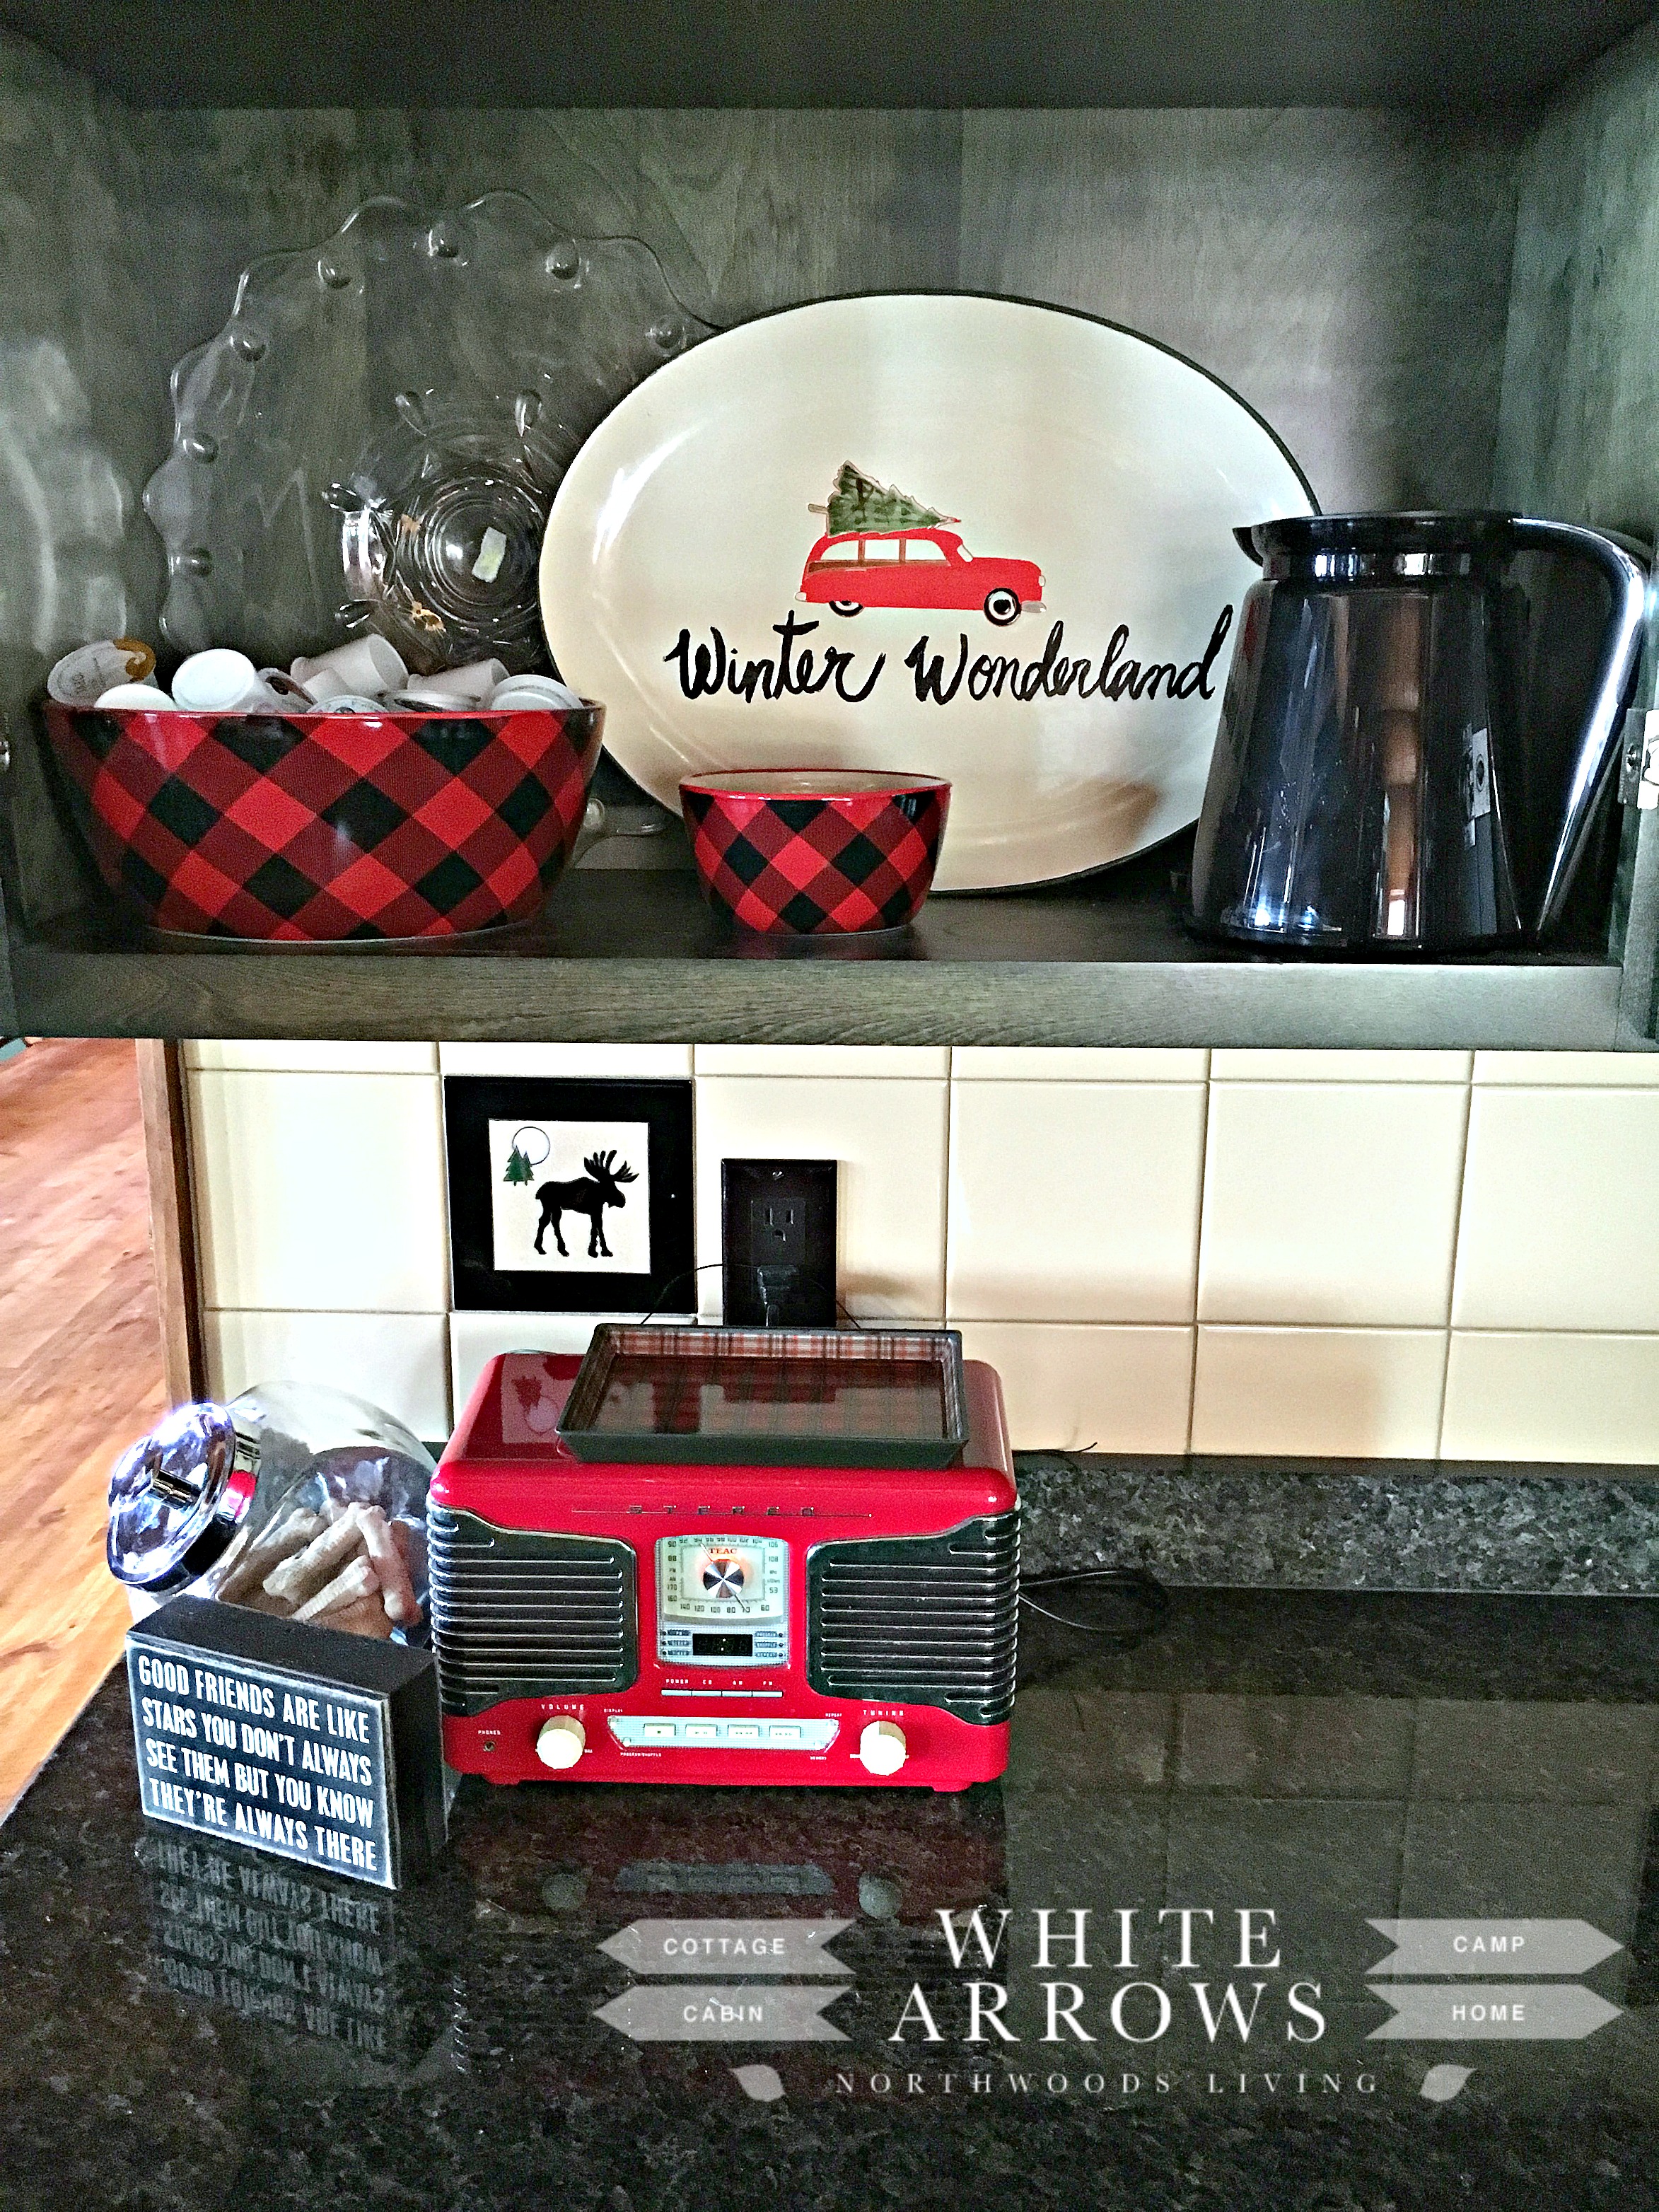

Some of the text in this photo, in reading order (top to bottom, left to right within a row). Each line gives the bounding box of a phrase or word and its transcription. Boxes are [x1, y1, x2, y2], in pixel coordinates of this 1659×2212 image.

[662, 603, 1233, 705] Winter Wonderland
[139, 1655, 370, 1744] GOOD FRIENDS ARE LIKE
[141, 1696, 372, 1786] STARS YOU DON'T ALWAYS
[145, 1737, 373, 1829] SEE THEM BUT YOU KNOW
[149, 1777, 378, 1871] THEY'RE ALWAYS THERE
